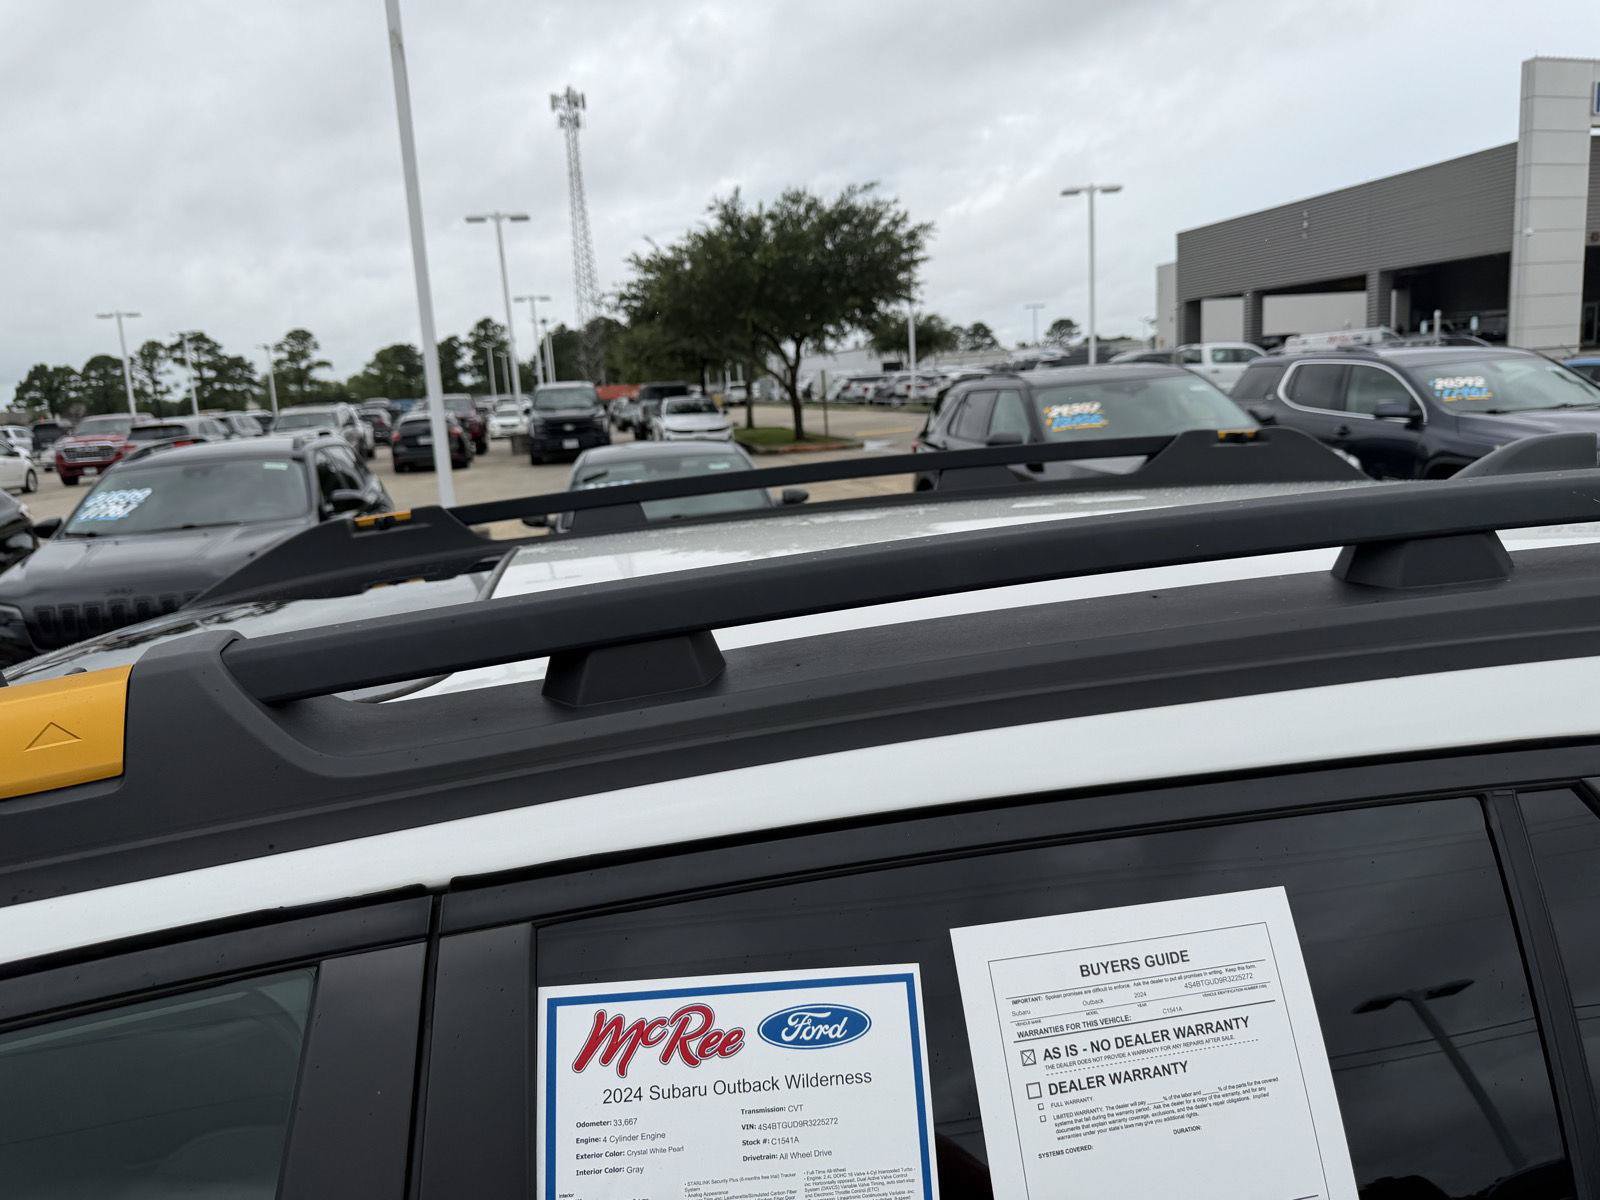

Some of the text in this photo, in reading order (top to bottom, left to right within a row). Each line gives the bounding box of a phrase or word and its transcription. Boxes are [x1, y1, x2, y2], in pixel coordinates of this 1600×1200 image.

[1079, 950, 1190, 978] BUYERS GUIDE
[1011, 996, 1042, 1006] IMPORTANT:
[1045, 993, 1062, 1001] Spoken
[1063, 990, 1083, 998] promises
[1092, 986, 1108, 994] difficult
[1183, 972, 1203, 980] promises
[1184, 972, 1253, 989] 4S4BTGUD9R3225272
[1082, 998, 1104, 1006] Outback
[1162, 1006, 1182, 1014] C1541A
[1011, 1009, 1031, 1017] Subaru
[1017, 1014, 1132, 1038] WARRANTIES FOR THIS VEHICLE:
[572, 1003, 848, 1078] McRee Ford
[1042, 1046, 1062, 1061] AS
[1065, 1044, 1078, 1058] IS
[1090, 1038, 1111, 1053] NO
[1114, 1029, 1171, 1049] DEALER
[1173, 1016, 1251, 1040] WARRANTY
[1056, 1060, 1076, 1069] DEALER
[1104, 1052, 1126, 1061] PROVIDE
[1132, 1047, 1160, 1056] WARRANTY
[1183, 1039, 1205, 1048] REPAIRS
[602, 1068, 872, 1105] 2024 Subaru Outback Wilderness
[1047, 1060, 1189, 1096] DEALER WARRANTY
[1053, 1112, 1073, 1121] LIMITED
[1115, 1102, 1130, 1110] dealer
[1261, 1076, 1279, 1084] covered
[741, 1104, 804, 1115] Transmission: CVT
[1056, 1125, 1081, 1135] documents
[1091, 1121, 1108, 1129] explain
[1108, 1117, 1128, 1126] warranty
[1252, 1092, 1270, 1100] Implied
[576, 1118, 637, 1128] Odometer: 33,667
[741, 1117, 838, 1131] VIN: 4S4BTGUD9R3225272
[1054, 1119, 1074, 1128] systems
[1115, 1109, 1135, 1117] warranty
[1057, 1132, 1082, 1142] warranties
[1164, 1114, 1185, 1123] additional
[576, 1136, 601, 1145] Engine:
[609, 1133, 639, 1144] Cylinder
[641, 1131, 666, 1142] Engine
[742, 1138, 760, 1146] Stock
[771, 1136, 799, 1145] C1541A
[576, 1152, 603, 1160] Exterior
[605, 1150, 625, 1158] Color:
[627, 1148, 648, 1158] Crystal
[668, 1145, 684, 1153] Pearl
[743, 1149, 832, 1162] Drivetrain: All Wheel Drive
[1038, 1149, 1064, 1159] SYSTEMS
[576, 1165, 644, 1176] Interior Color: Gray
